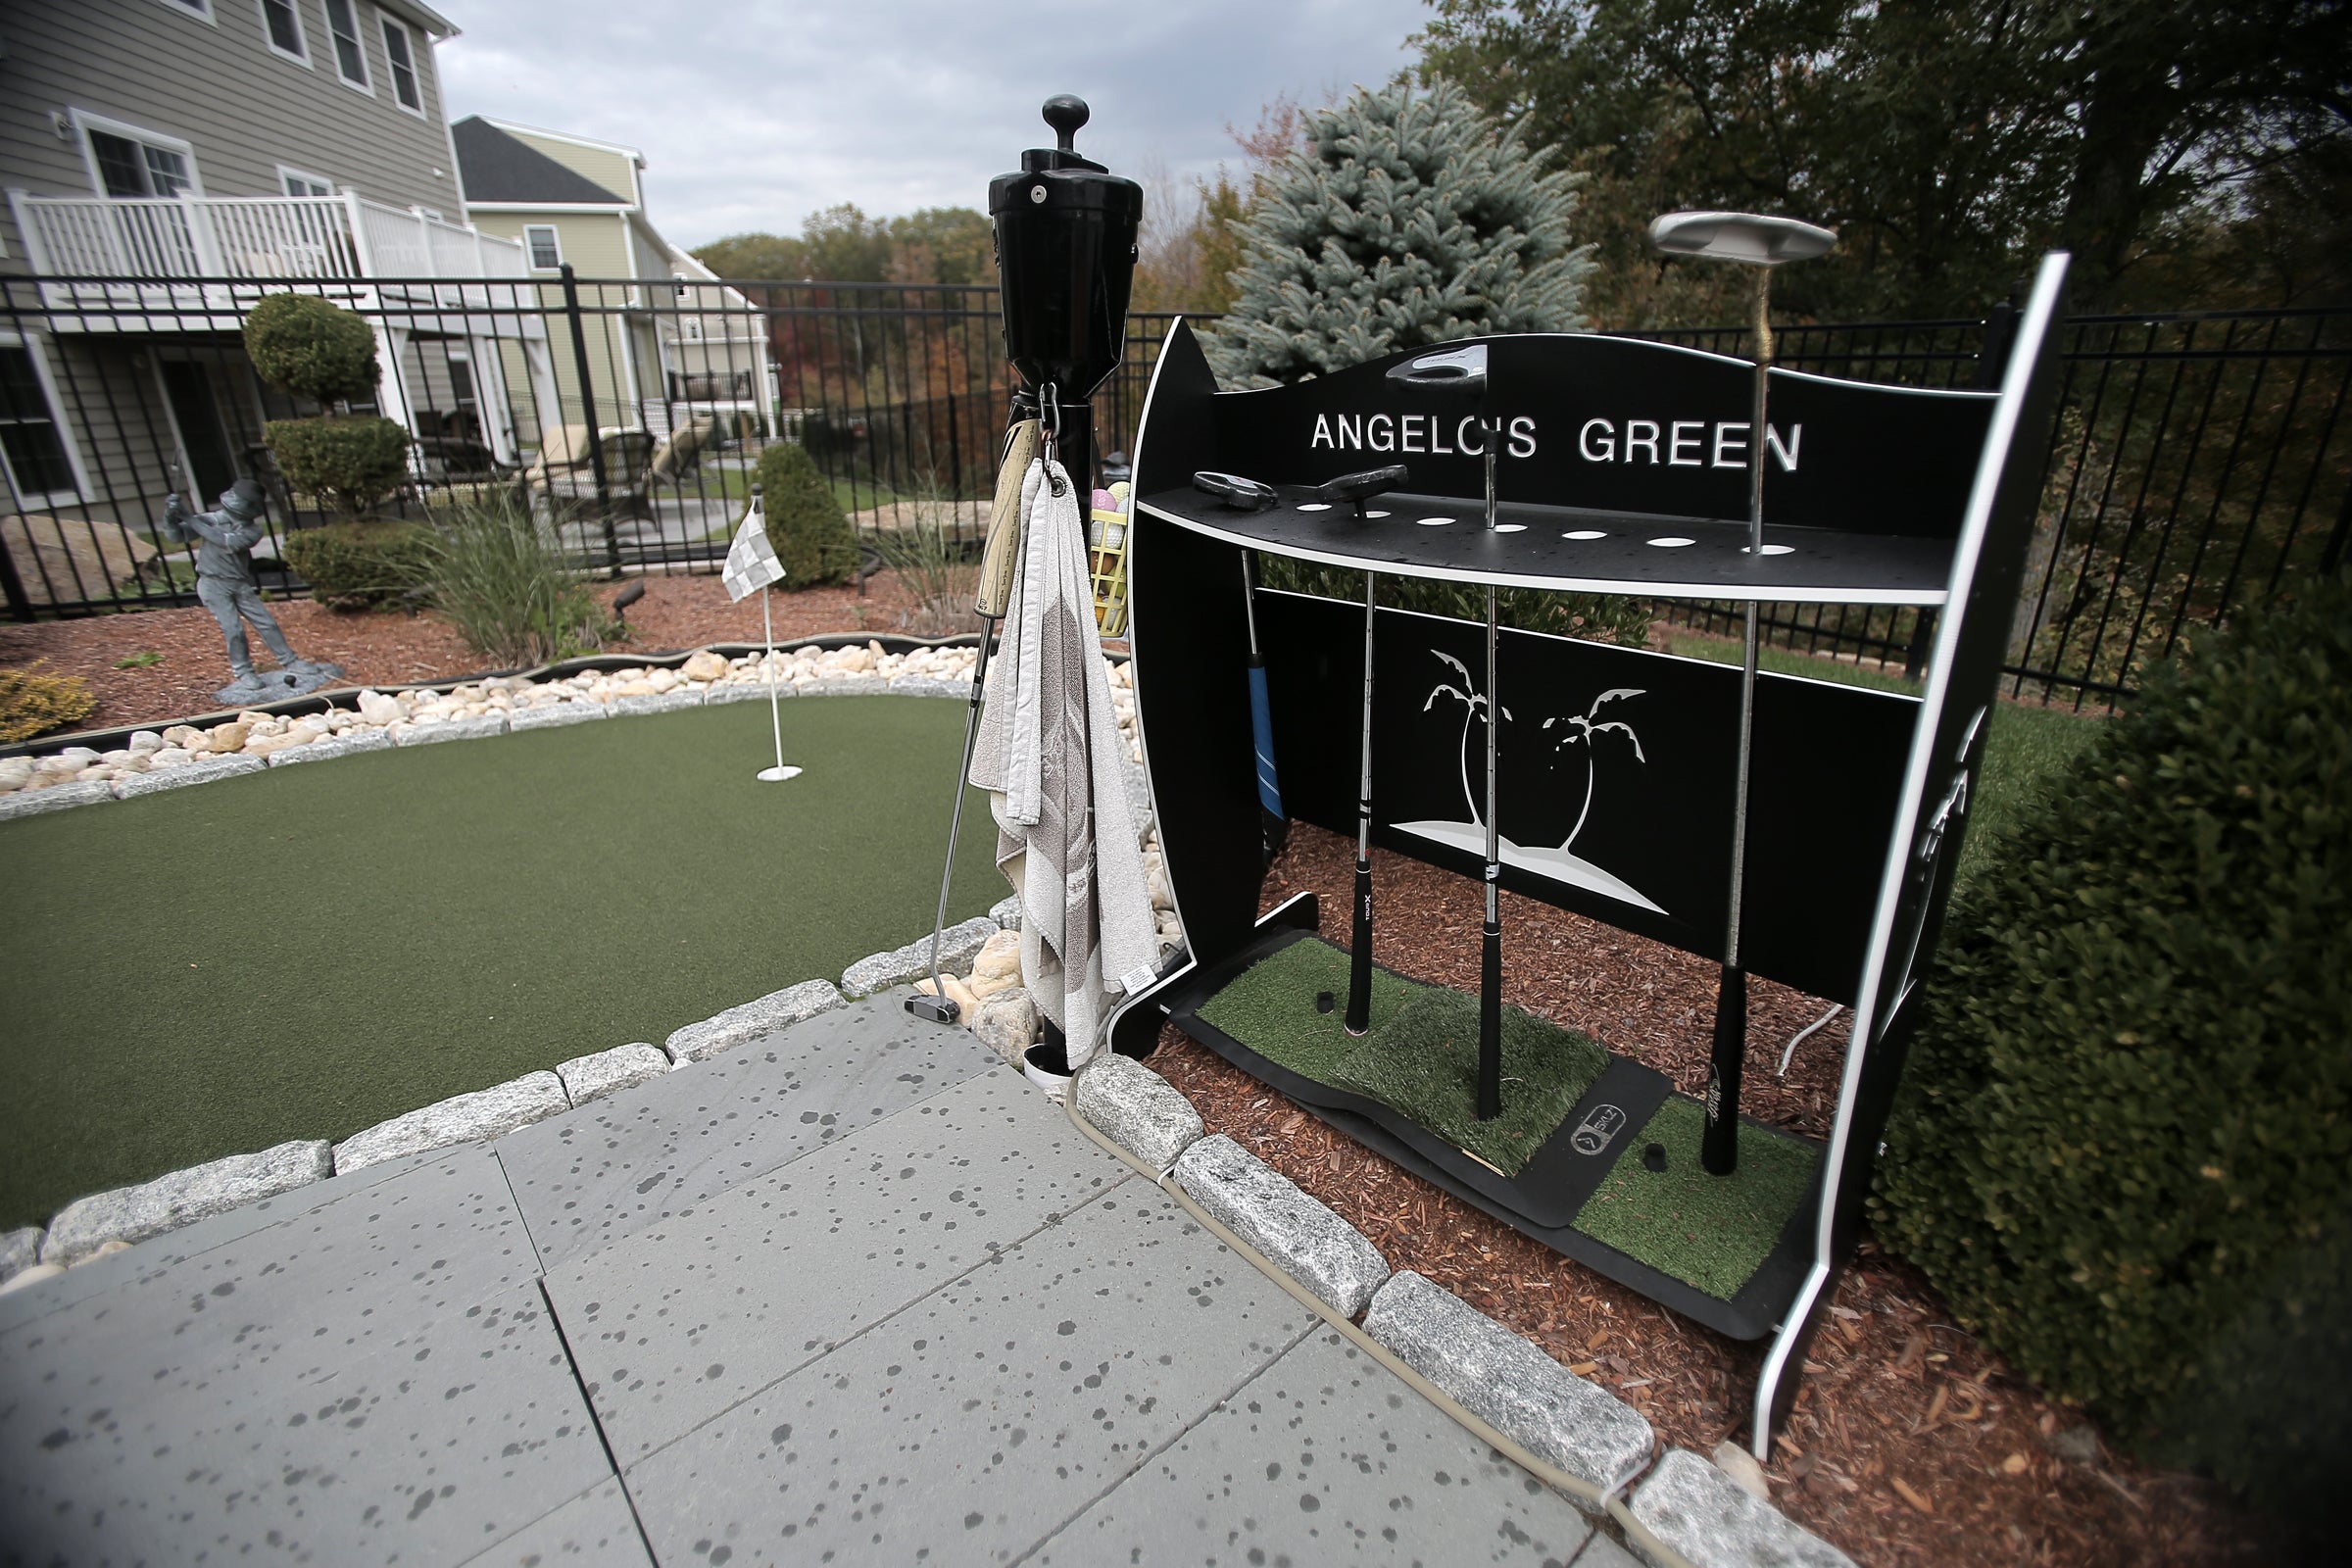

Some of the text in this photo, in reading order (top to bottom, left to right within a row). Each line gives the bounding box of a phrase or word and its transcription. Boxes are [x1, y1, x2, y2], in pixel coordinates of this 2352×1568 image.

[1311, 413, 1802, 471] ANGELO'S GREEN
[1593, 1108, 1618, 1131] SKLZ
